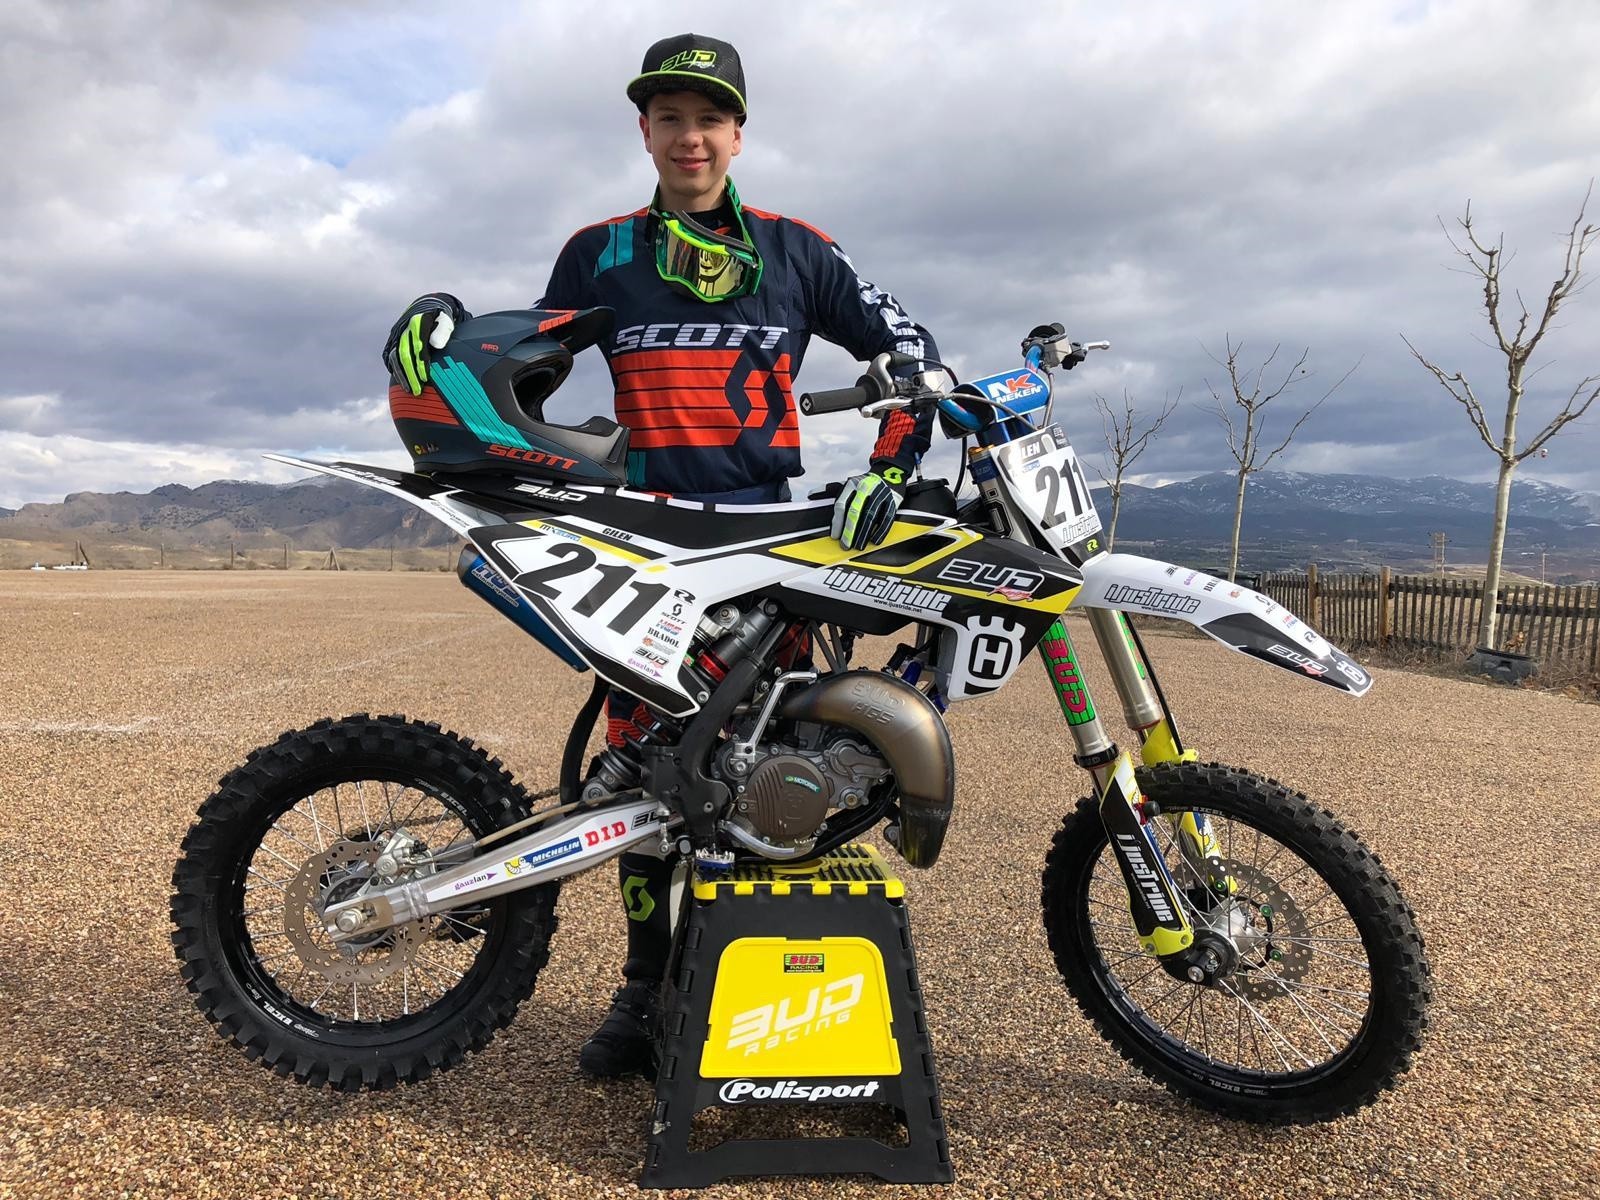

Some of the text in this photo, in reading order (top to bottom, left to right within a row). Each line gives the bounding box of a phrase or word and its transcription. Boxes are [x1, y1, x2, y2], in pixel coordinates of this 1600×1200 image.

[611, 323, 789, 354] SCOTT
[996, 386, 1042, 404] NEKEN
[486, 444, 579, 470] SCOTT
[1036, 457, 1092, 530] 211
[602, 527, 633, 541] GILEN
[514, 542, 671, 636] 211
[647, 626, 680, 649] BRADOL
[441, 791, 468, 816] EXCEL
[1192, 806, 1225, 817] EXCEL
[584, 821, 627, 847] D.I.D
[532, 841, 580, 863] MICHELIN
[454, 873, 487, 891] gauzlan
[262, 1000, 293, 1024] EXCEL
[727, 1080, 880, 1102] Polisport
